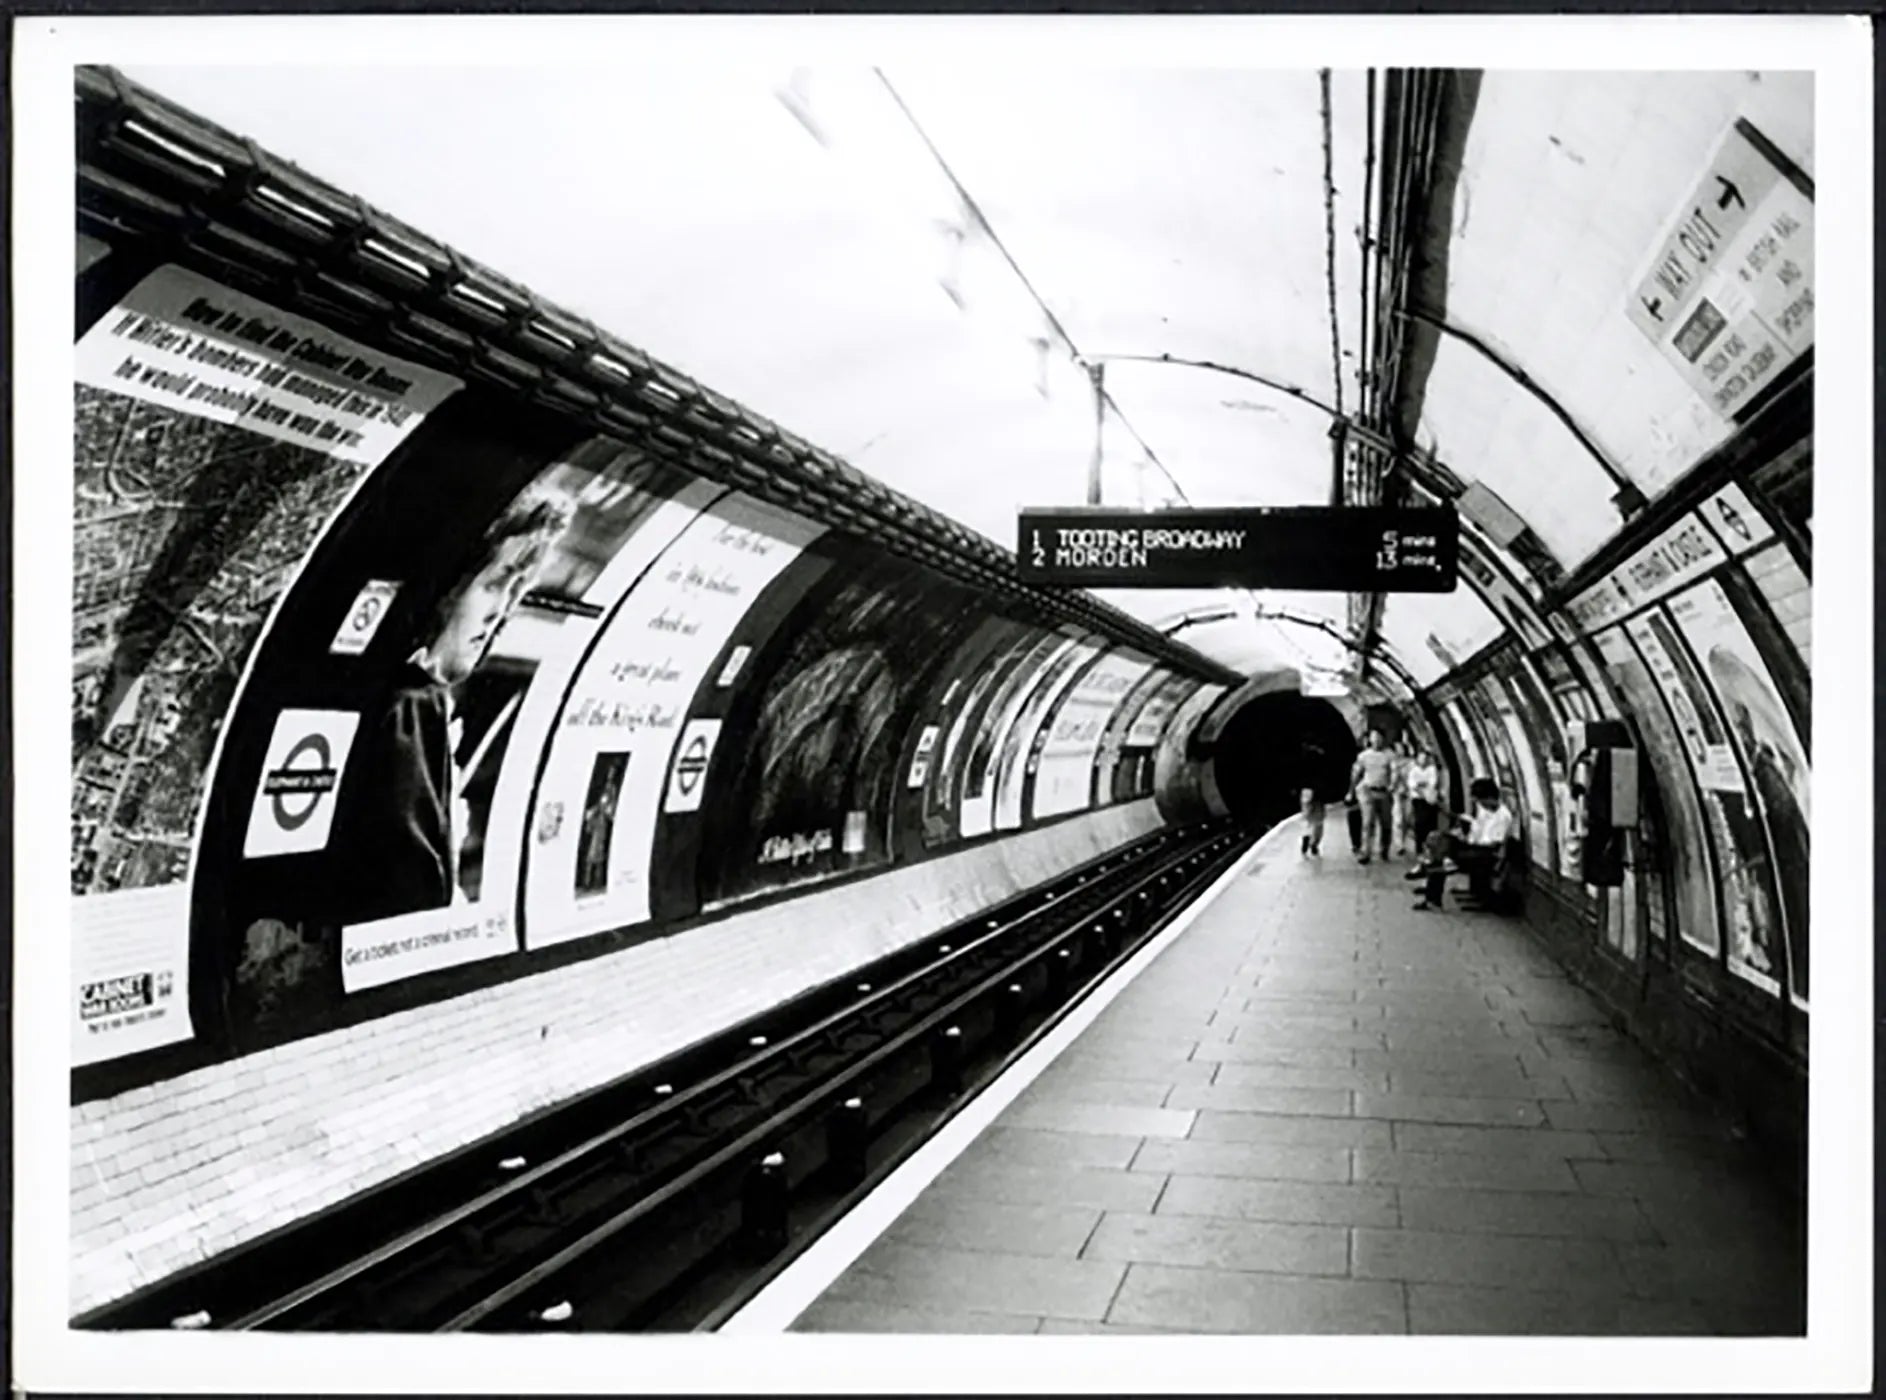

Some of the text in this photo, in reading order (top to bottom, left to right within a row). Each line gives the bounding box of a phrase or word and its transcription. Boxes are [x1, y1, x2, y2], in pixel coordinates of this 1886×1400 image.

[1654, 250, 1690, 300] WAY
[1678, 206, 1721, 264] OUT
[127, 316, 194, 356] Hitler's
[188, 336, 260, 377] bombers
[280, 371, 350, 408] managed
[113, 354, 143, 381] he
[139, 364, 198, 397] would
[187, 379, 260, 417] probably
[251, 398, 295, 425] have
[313, 418, 345, 442] the
[1032, 529, 1437, 550] 1 TOOTING BROADWAY 5 mins
[1032, 549, 1046, 568] 2
[1055, 549, 1148, 568] MORDEN
[1375, 550, 1398, 570] 13
[608, 703, 644, 733] King's
[345, 946, 362, 966] Get
[370, 940, 399, 960] ticket
[80, 973, 143, 1001] CABINET
